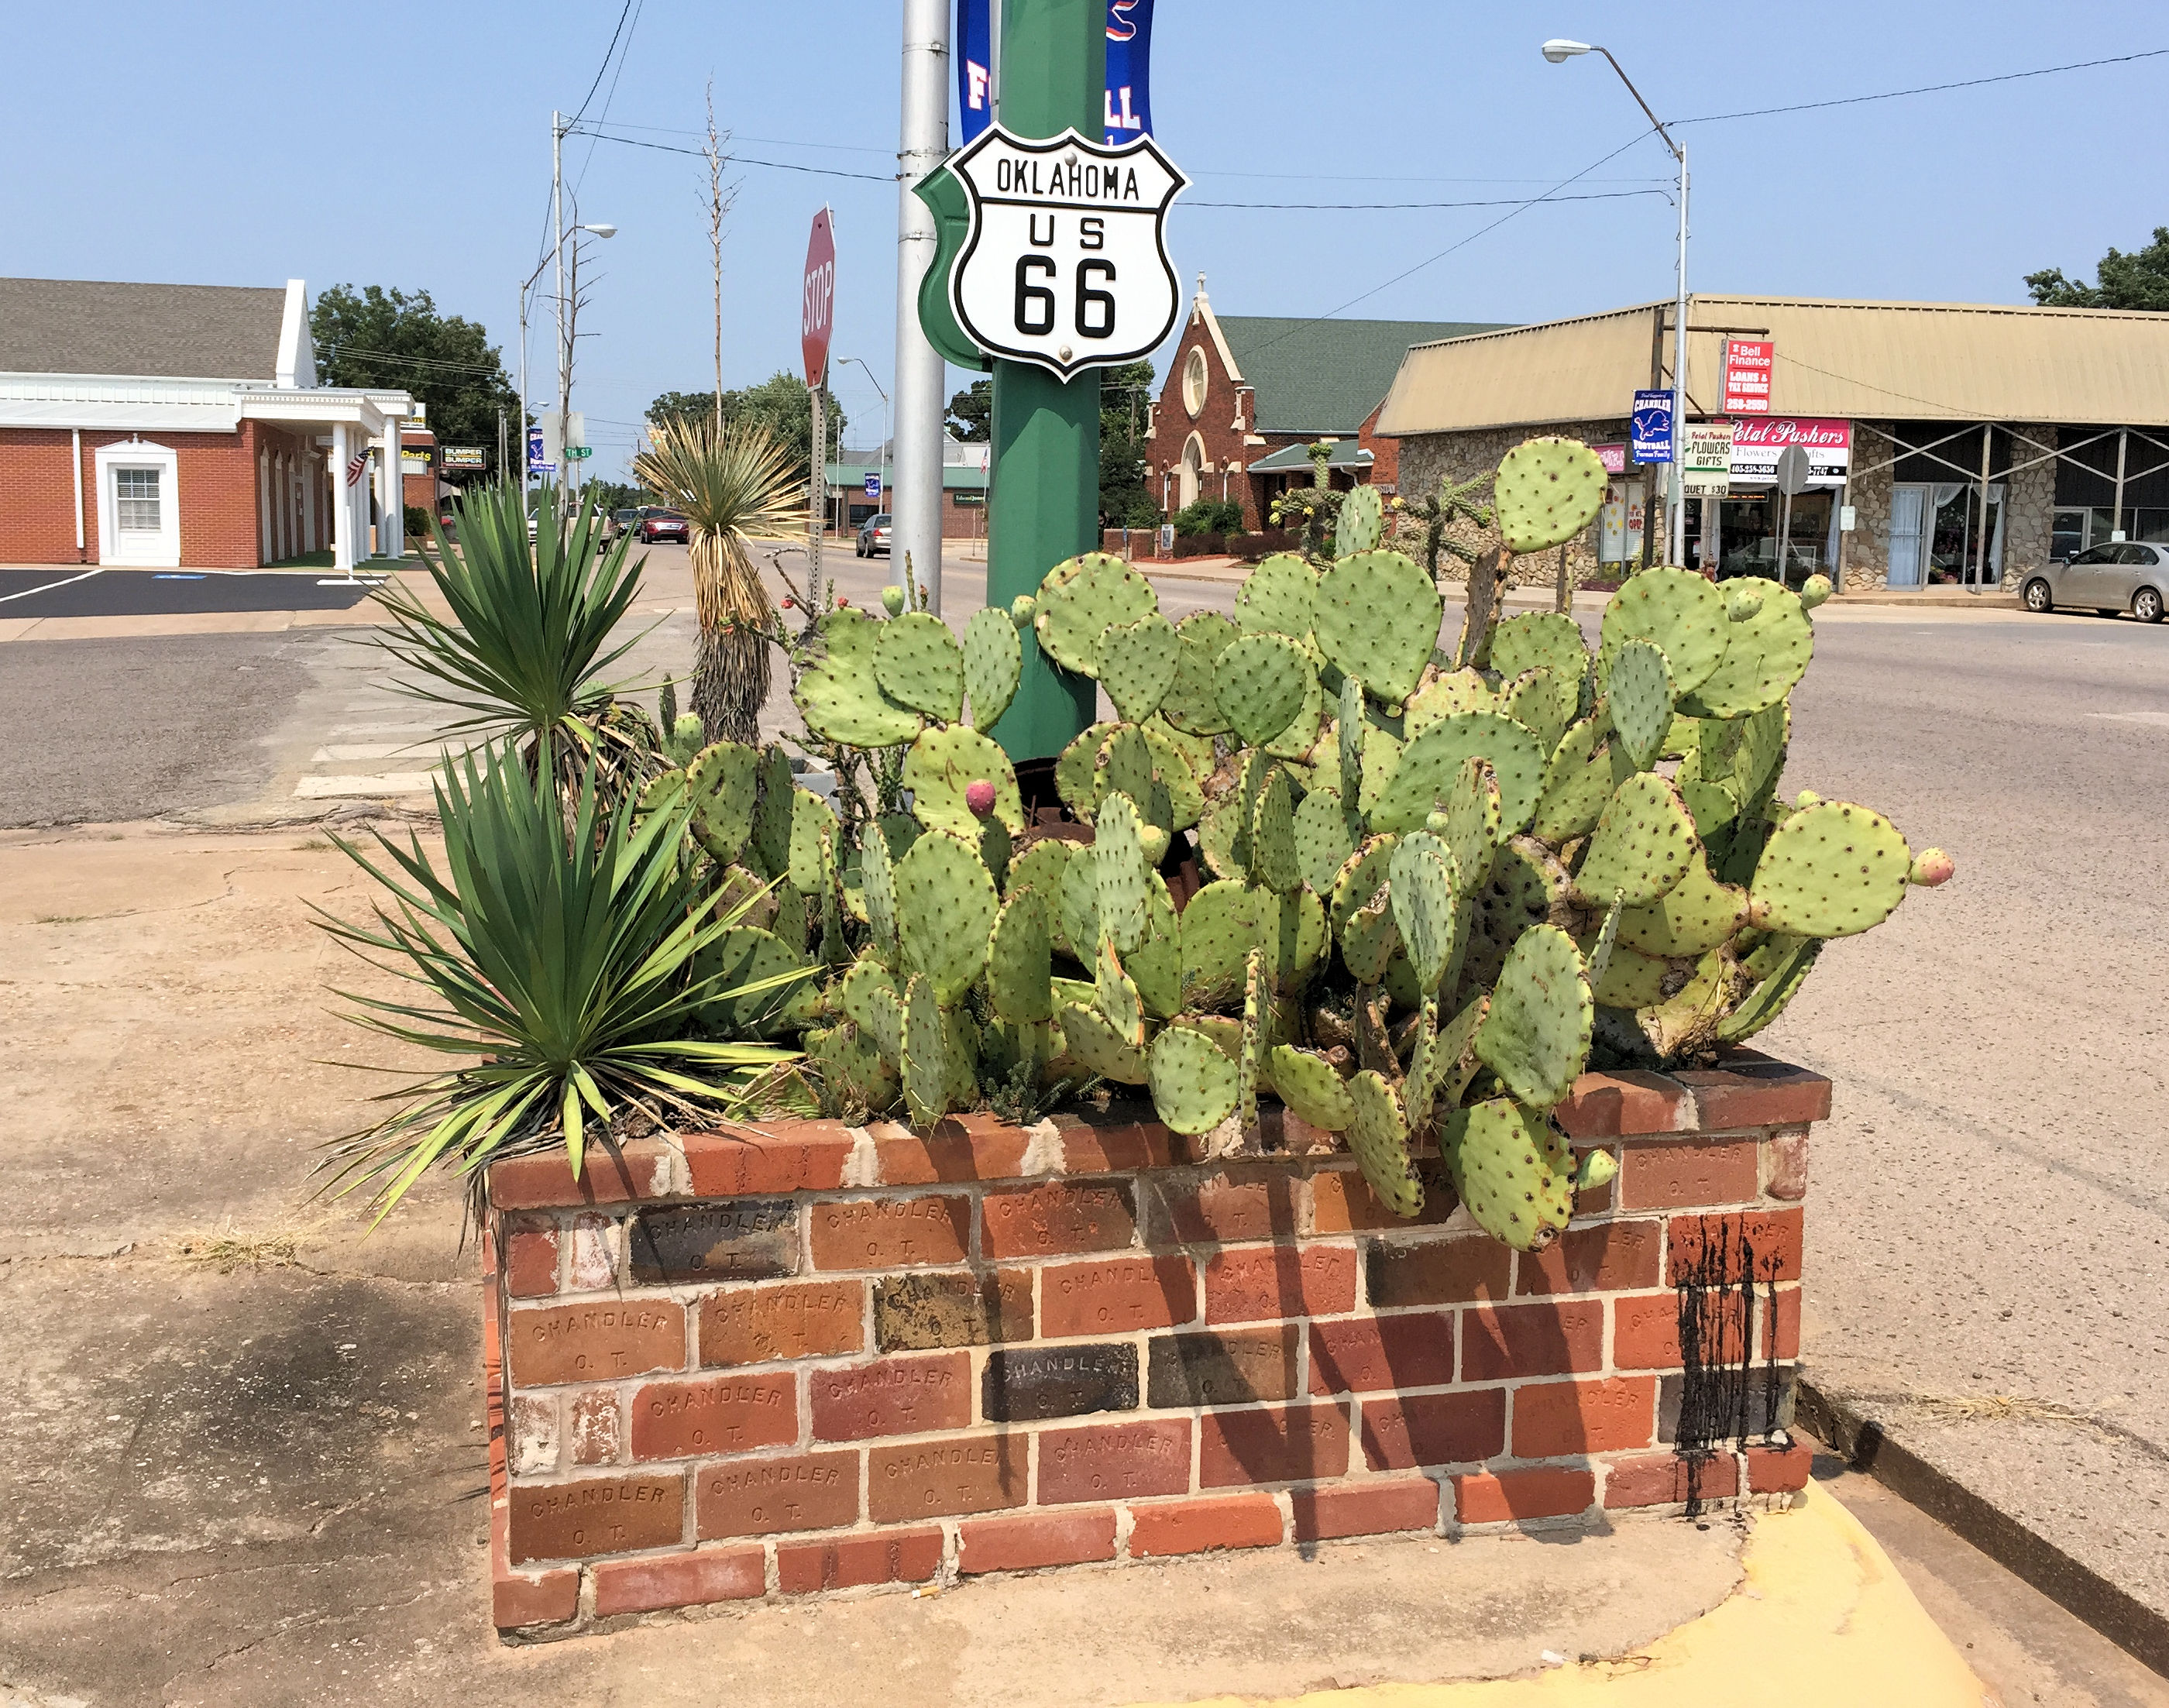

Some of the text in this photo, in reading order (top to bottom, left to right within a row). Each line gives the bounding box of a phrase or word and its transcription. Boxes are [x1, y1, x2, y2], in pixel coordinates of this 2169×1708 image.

[997, 158, 1139, 201] OKLAHOMA
[803, 260, 833, 336] STOP
[1014, 254, 1116, 339] 66
[1741, 345, 1761, 356] Bell
[1729, 355, 1771, 366] Finance
[1730, 372, 1768, 382] LOANS &
[1728, 383, 1769, 393] TAX SERVICE
[1634, 399, 1671, 413] CHANDLER
[1691, 431, 1707, 440] Petal
[1770, 421, 1844, 444] Pushers
[1633, 439, 1671, 450] FOOTBALL
[1691, 441, 1731, 455] FLOWERS
[565, 448, 590, 457] TH ST
[1736, 446, 1825, 459] Flowers ifts
[1696, 455, 1722, 466] GIFTS
[1683, 485, 1727, 494] QUET $30
[531, 1311, 668, 1342] CHANDLER
[650, 1386, 782, 1418] CHANDLER
[711, 1466, 839, 1497] CHANDLER
[531, 1486, 665, 1517] CHANDLER
